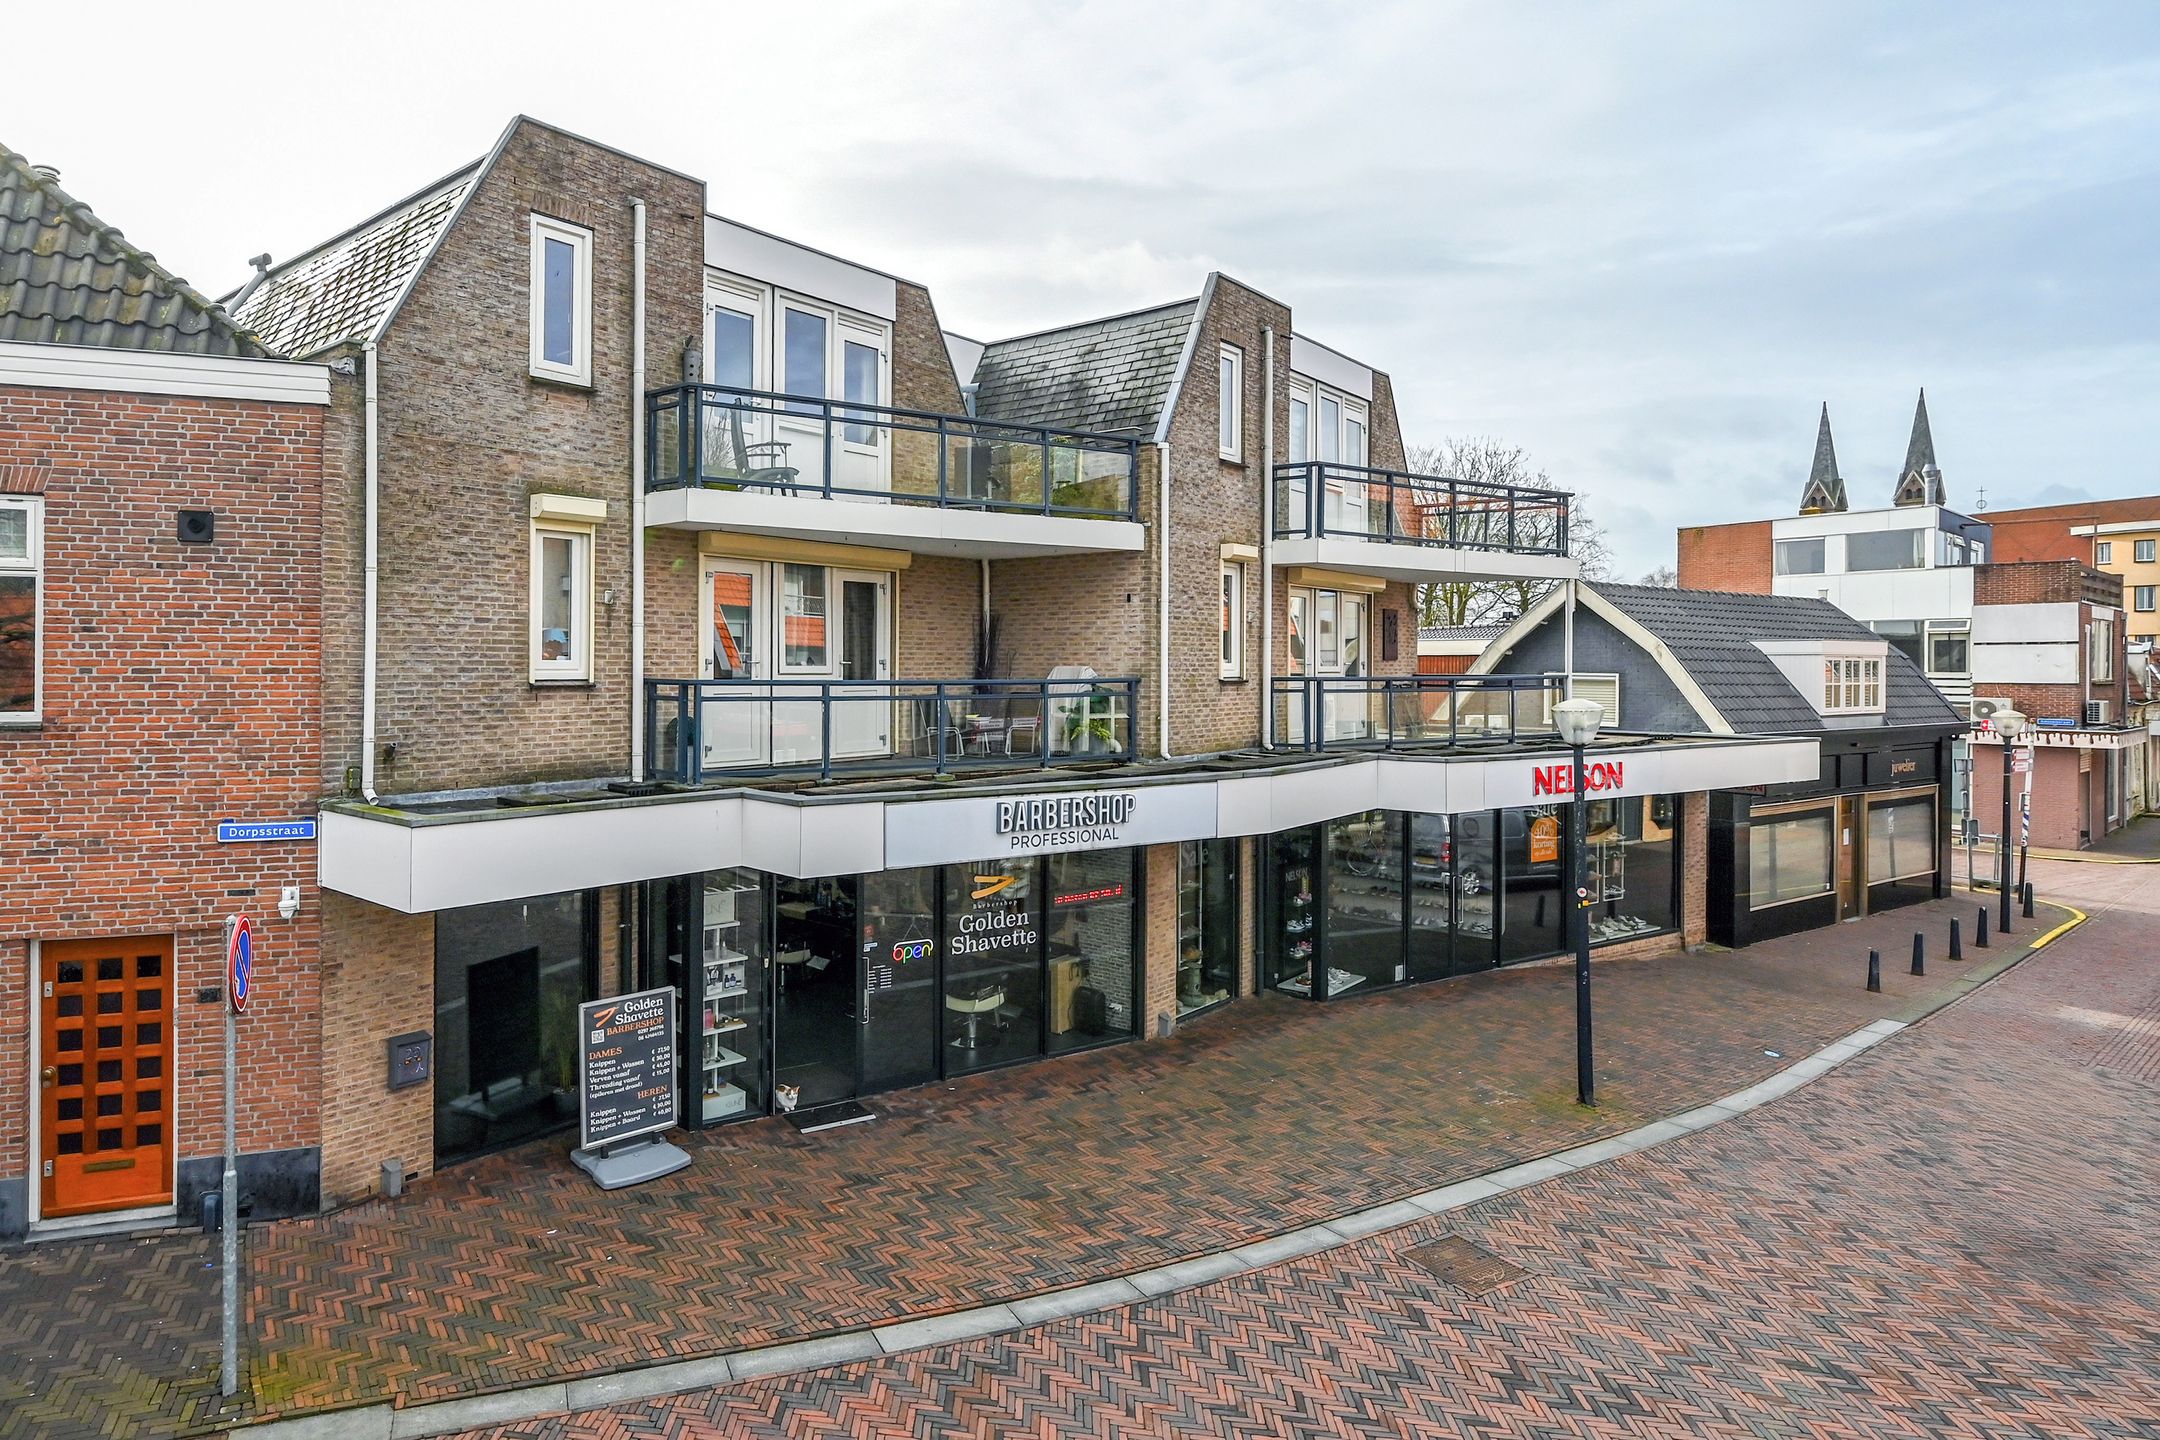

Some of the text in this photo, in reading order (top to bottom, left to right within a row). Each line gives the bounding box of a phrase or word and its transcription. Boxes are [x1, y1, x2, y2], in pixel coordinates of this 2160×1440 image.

[996, 794, 1137, 834] BARBERSHOP
[229, 827, 305, 838] Dorpsstraat
[1011, 827, 1119, 849] PROFESSIONAL
[959, 910, 1030, 934] Golden
[951, 929, 1037, 955] Shavette
[892, 944, 932, 964] open
[624, 997, 664, 1013] Golden
[614, 1007, 664, 1025] Shavette
[606, 1016, 665, 1036] BARBERSHOP
[589, 1046, 623, 1060] DAMES
[589, 1059, 616, 1069] Knippen
[589, 1066, 616, 1077] Knippen
[589, 1074, 612, 1084] Verven
[637, 1084, 668, 1099] HEREN
[590, 1107, 617, 1118] Knippen
[590, 1114, 617, 1126] Knippen
[590, 1121, 617, 1133] Knippen
